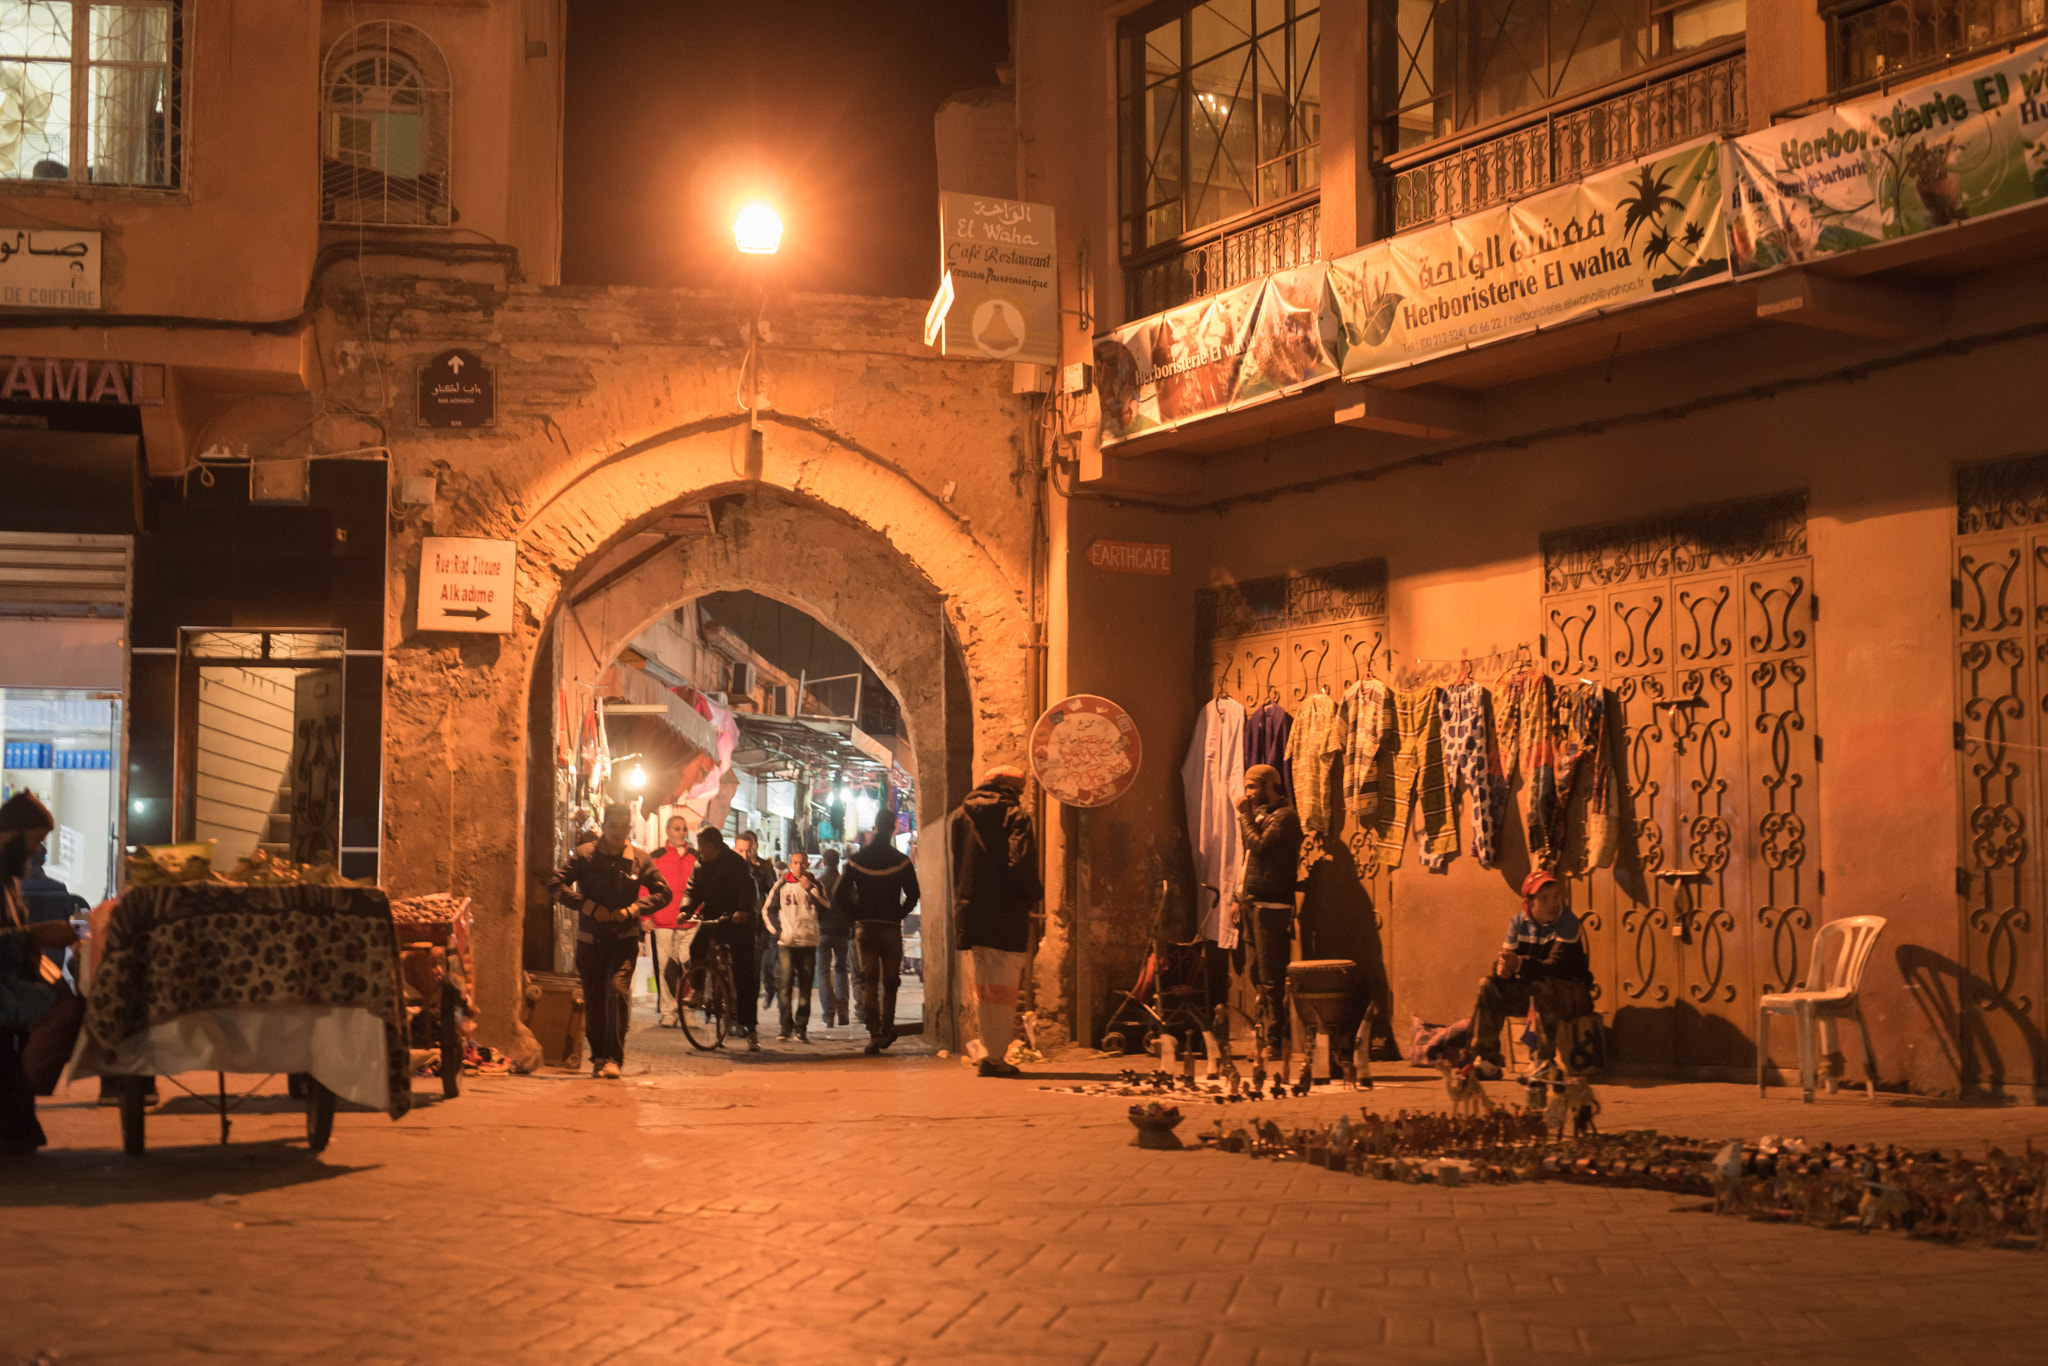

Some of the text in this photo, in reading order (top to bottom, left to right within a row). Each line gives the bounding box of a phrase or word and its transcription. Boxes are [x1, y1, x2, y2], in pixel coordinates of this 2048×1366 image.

[1973, 71, 2010, 112] El
[957, 218, 1039, 246] El Waha
[947, 242, 1051, 269] Café Restaurant
[985, 267, 1049, 292] Panoramique
[1403, 246, 1632, 331] Herboristerie El waha
[4, 286, 95, 306] DE COIFFURE
[1135, 349, 1209, 386] Herboristerie
[1209, 344, 1222, 362] El
[1092, 543, 1171, 570] EARTHCAFE
